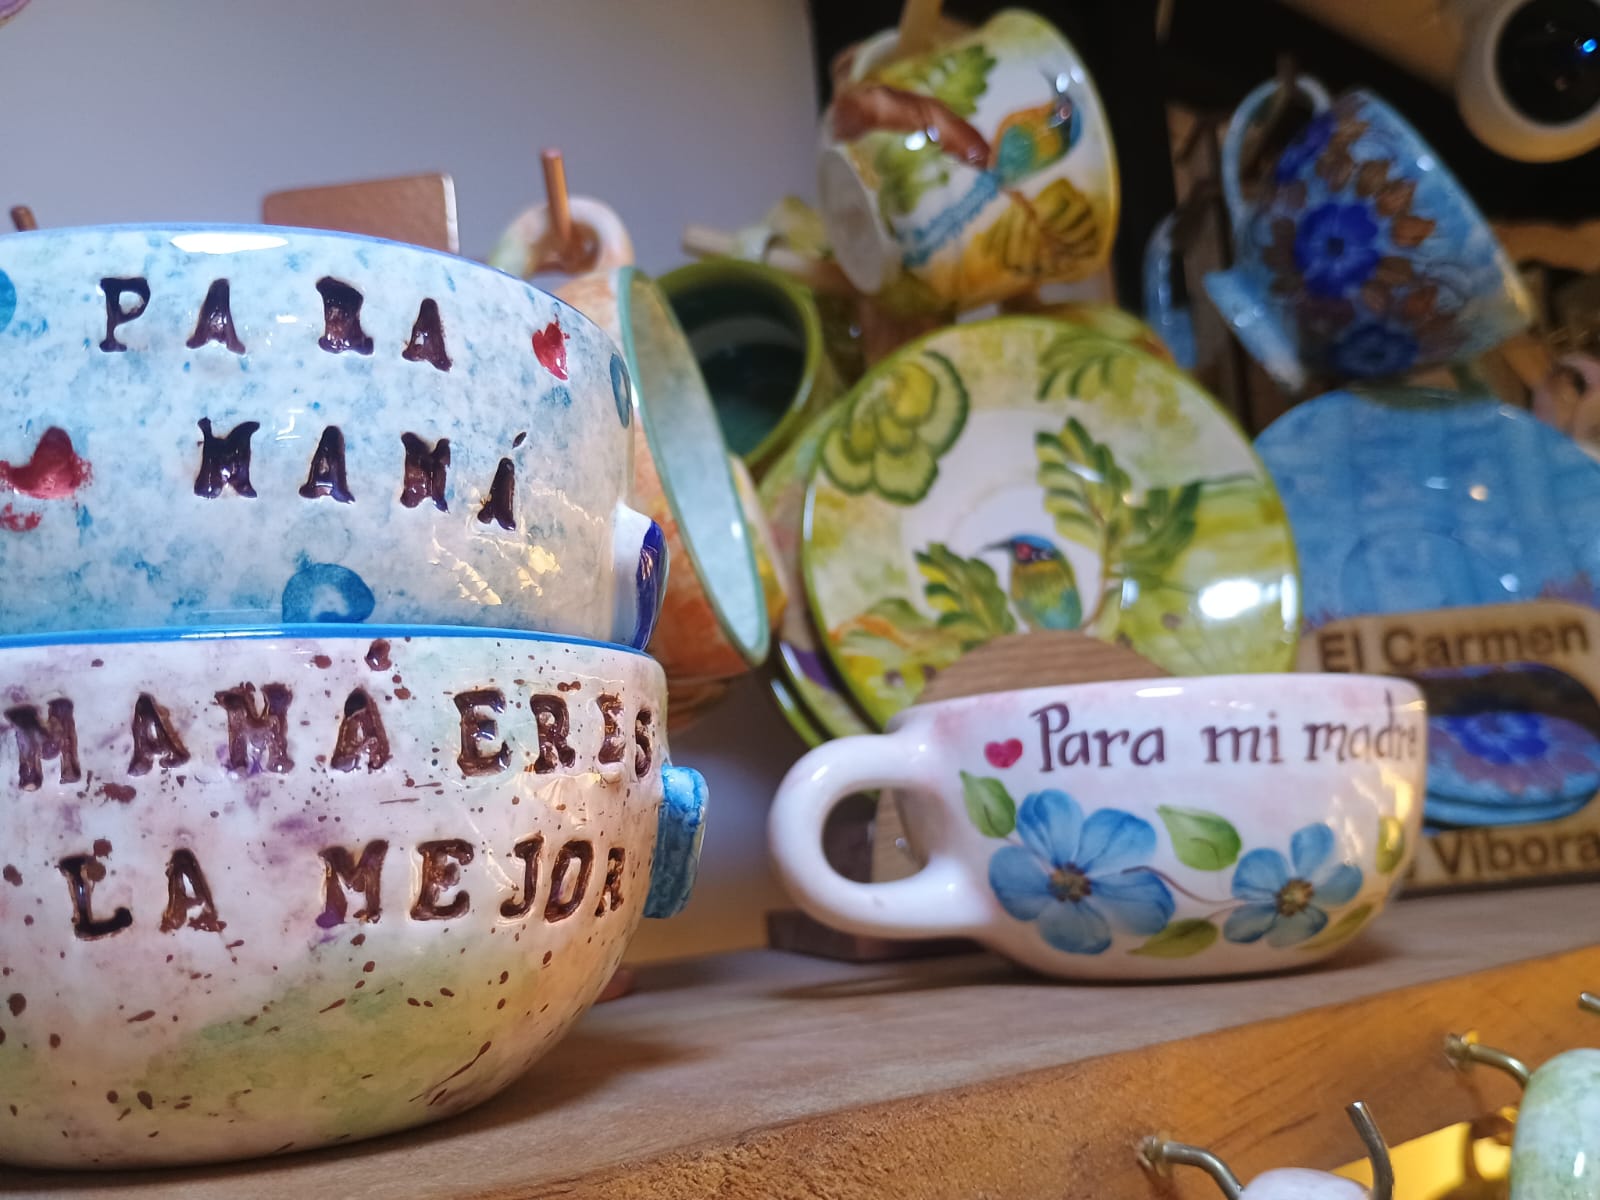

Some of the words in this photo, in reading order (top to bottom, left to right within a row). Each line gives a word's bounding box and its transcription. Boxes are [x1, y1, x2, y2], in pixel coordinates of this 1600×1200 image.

[100, 276, 452, 371] PARA
[1318, 630, 1364, 673] El
[1382, 617, 1591, 670] Carmen
[4, 681, 392, 791] MAMA
[454, 688, 652, 780] ERES
[1028, 702, 1166, 773] Para
[1200, 709, 1284, 764] mi
[56, 847, 228, 941] LA
[316, 832, 626, 928] MEJOR
